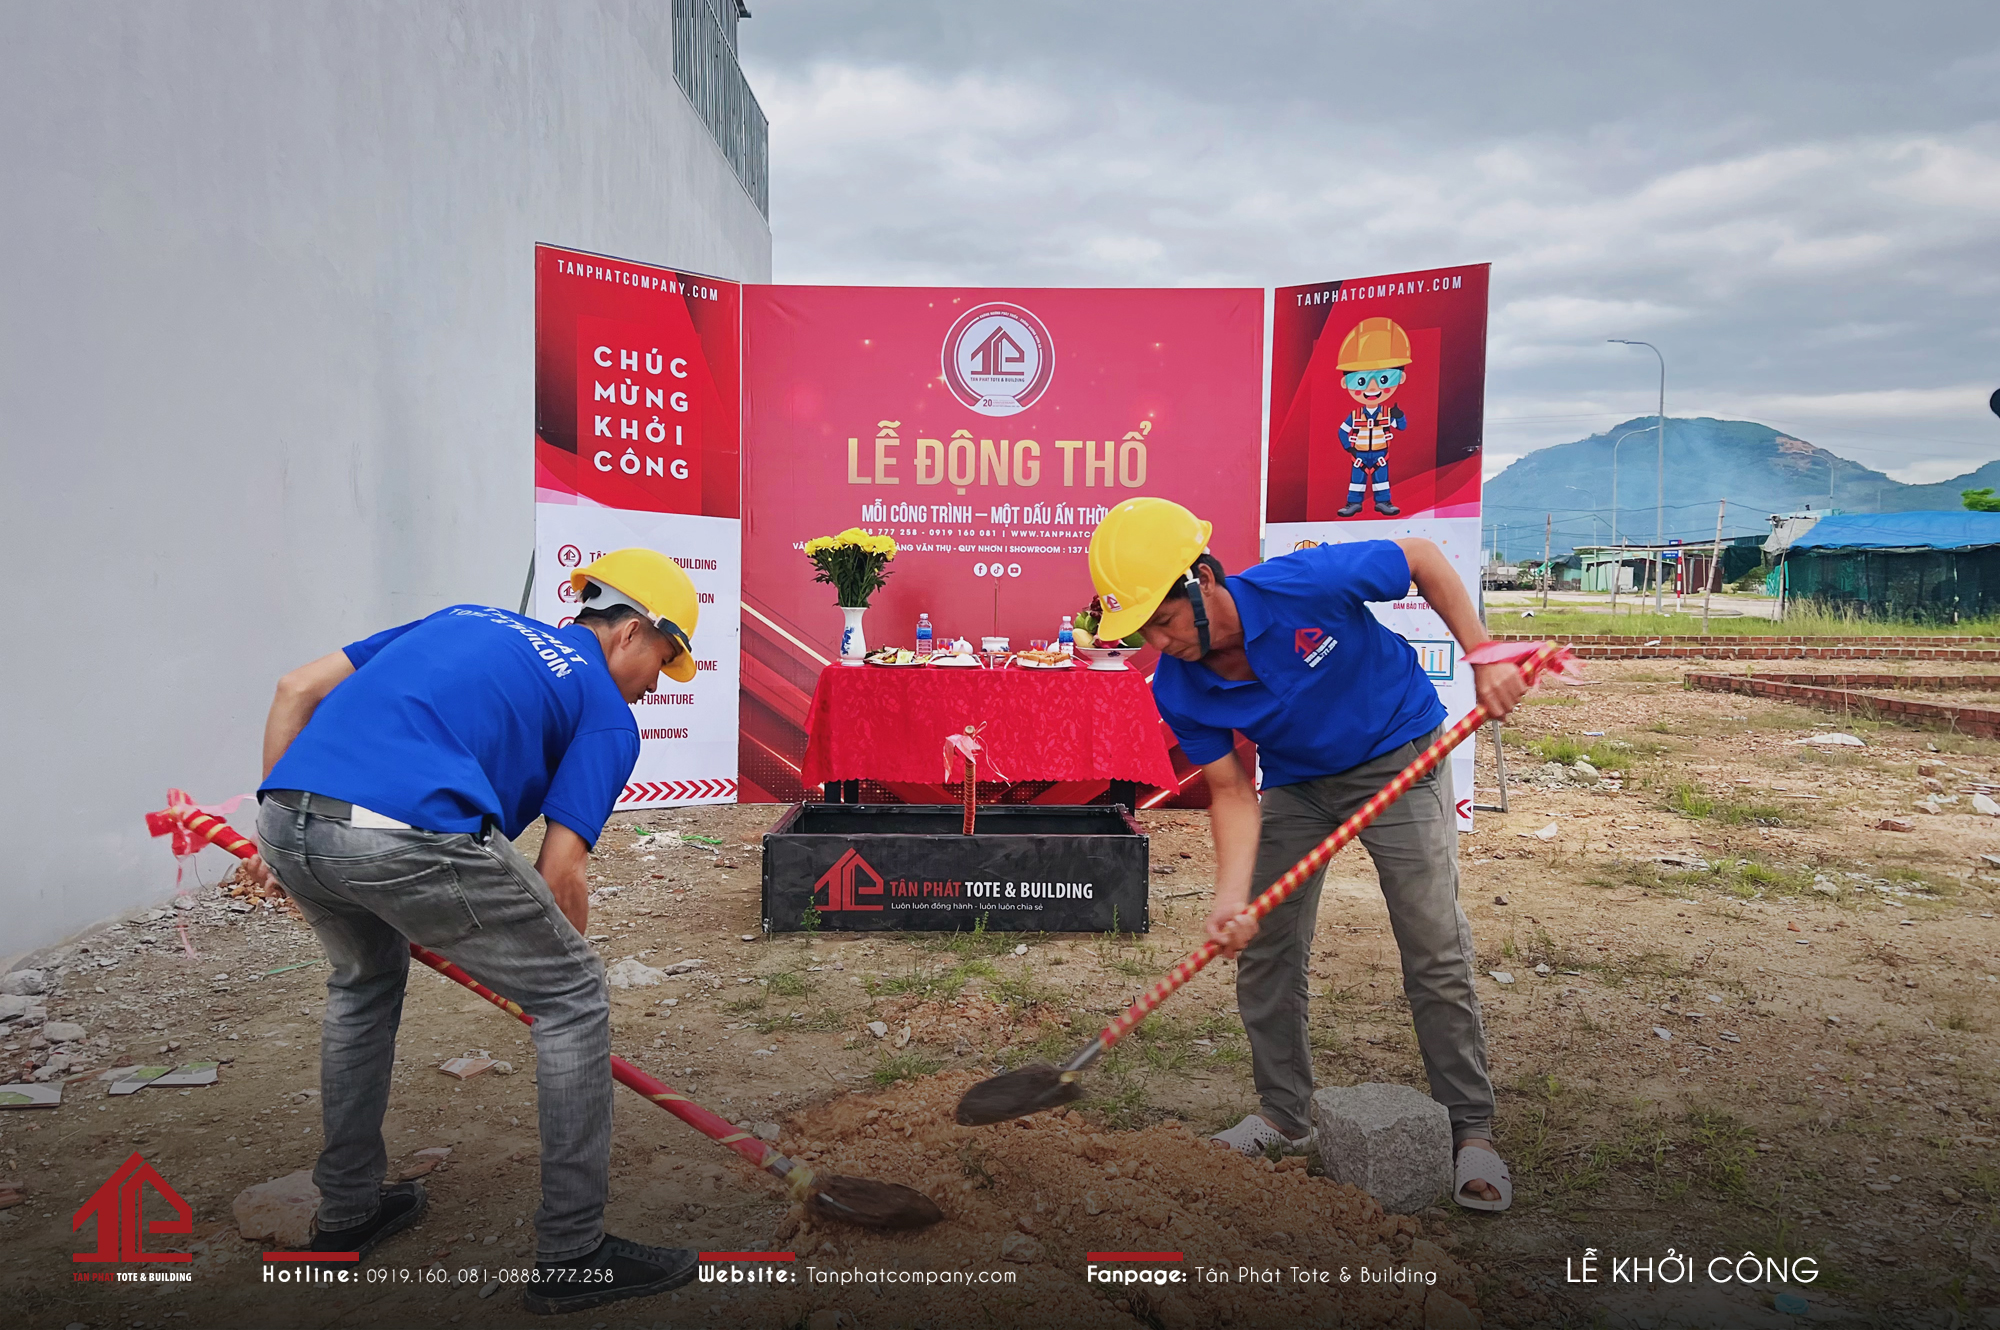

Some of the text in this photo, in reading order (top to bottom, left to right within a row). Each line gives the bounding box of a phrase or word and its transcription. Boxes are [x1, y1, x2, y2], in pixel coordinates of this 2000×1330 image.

[557, 259, 719, 302] TANPHATCOMPANY.COM
[1296, 275, 1463, 307] TANPHATCOMPANY.COM
[593, 345, 688, 379] CHÚC
[593, 378, 689, 412] MỪNG
[982, 398, 992, 407] 20
[593, 414, 683, 446] KHỞI
[593, 447, 689, 480] CÔNG
[847, 420, 1152, 495] LỄ ĐỘNG THỔ
[862, 498, 886, 522] MỖI
[890, 502, 928, 524] CÔNG
[930, 502, 972, 524] TRÌNH
[990, 503, 1020, 528] MỘT
[1024, 502, 1052, 525] DẤU
[1054, 502, 1074, 525] ẤN
[929, 528, 954, 536] 0919
[1010, 530, 1095, 538] WWW.TANPHATC
[916, 542, 934, 552] VĂN
[936, 544, 952, 554] THỤ
[958, 544, 976, 552] QUY
[978, 544, 1002, 553] NHƠN
[1010, 545, 1060, 554] SHOWROOM
[1068, 546, 1082, 554] 137
[1393, 601, 1405, 610] ĐẢM
[1406, 601, 1417, 610] BẢO
[641, 694, 694, 706] FURNITURE
[640, 728, 688, 740] WINDOWS
[890, 878, 1093, 899] TÂN PHÁT TOTE & BUILDING
[891, 902, 911, 910] Luôn
[912, 902, 930, 910] luôn
[953, 902, 973, 910] hành
[1016, 902, 1034, 911] chia
